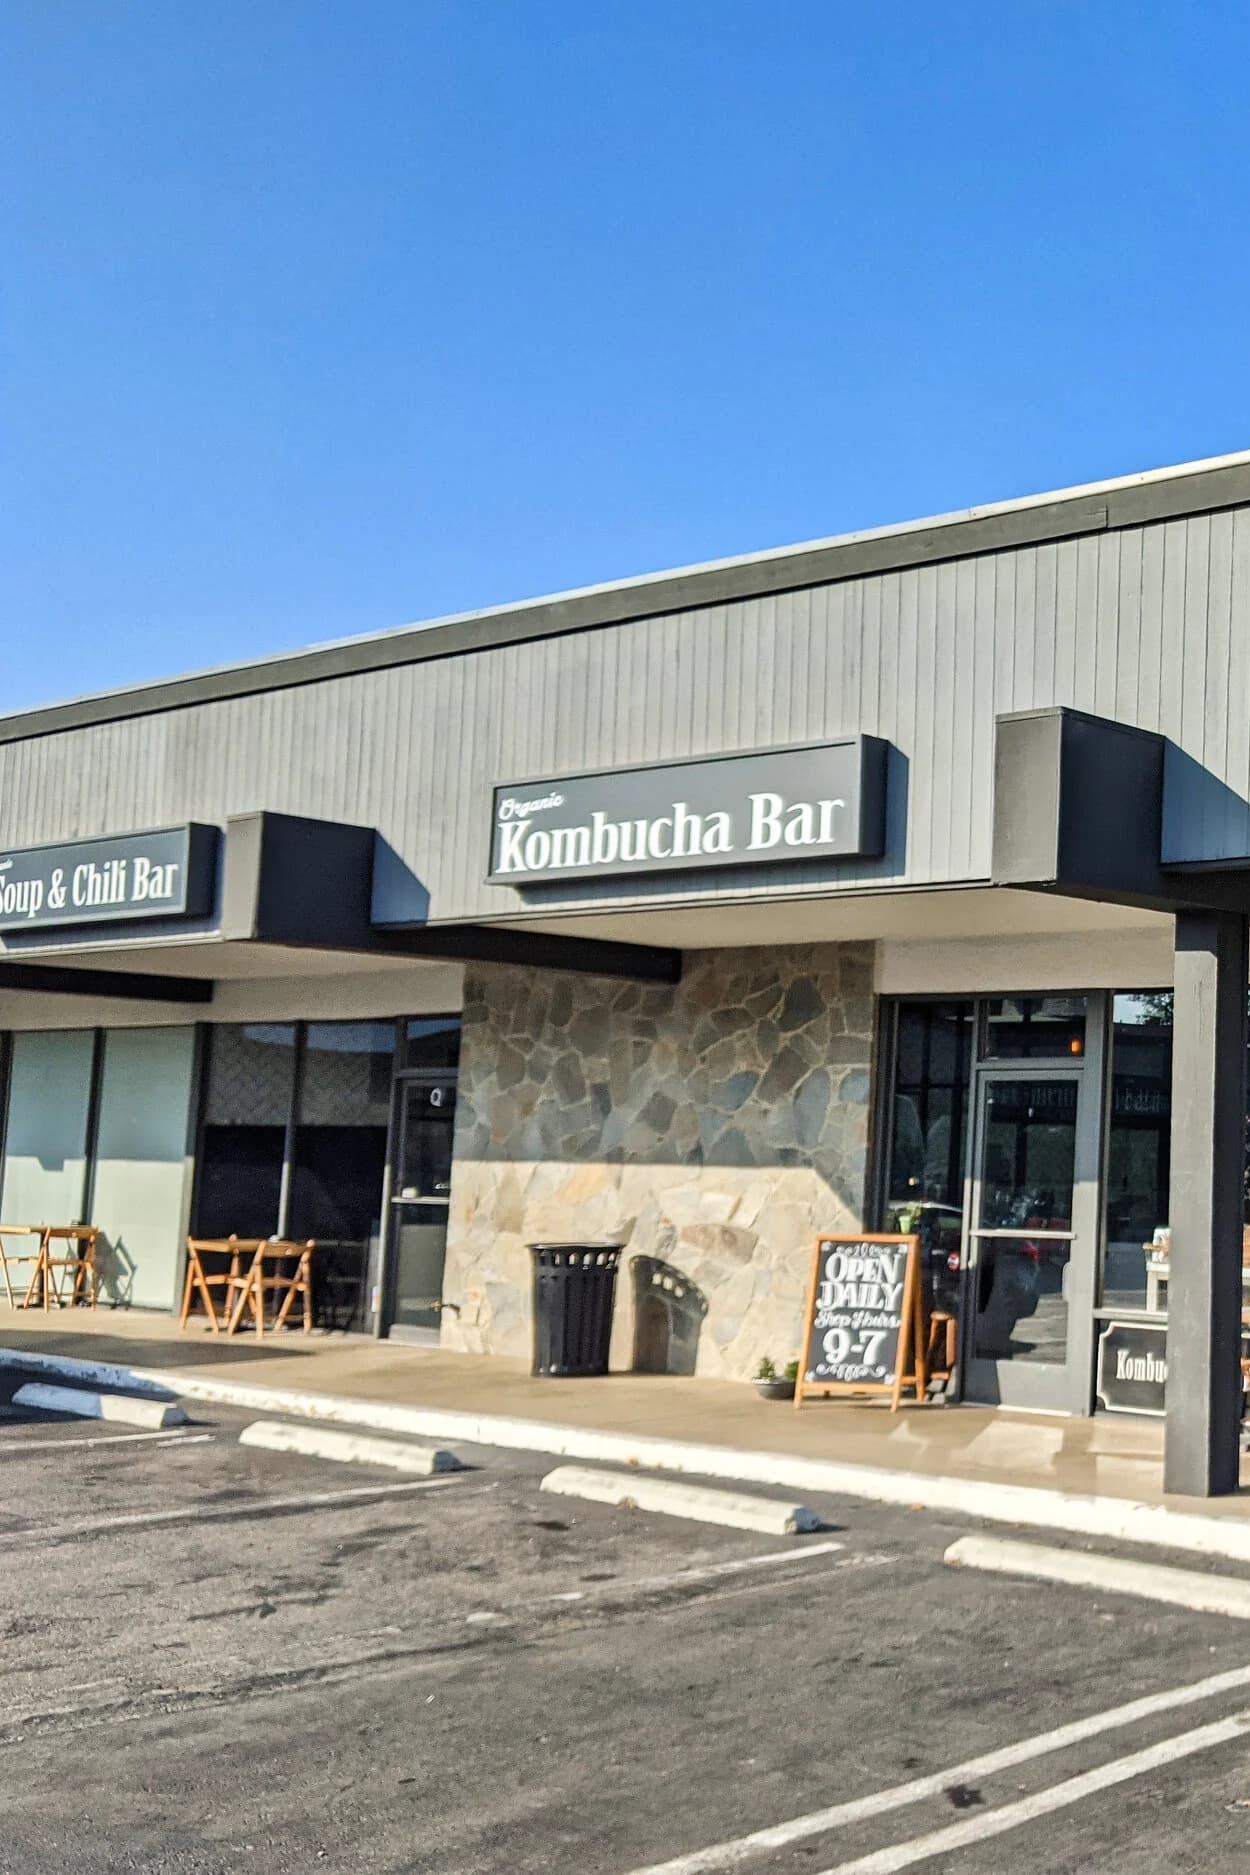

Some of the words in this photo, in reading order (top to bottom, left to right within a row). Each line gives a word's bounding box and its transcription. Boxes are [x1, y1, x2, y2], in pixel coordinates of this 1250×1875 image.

[498, 791, 565, 820] Organic
[496, 802, 734, 874] Kombucha
[745, 792, 844, 851] Bar
[48, 868, 67, 909] &
[72, 858, 127, 906] Chili
[131, 856, 179, 901] Bar
[825, 1253, 902, 1284] OPEN
[816, 1282, 903, 1311] DAILY
[823, 1327, 888, 1365] 9-7
